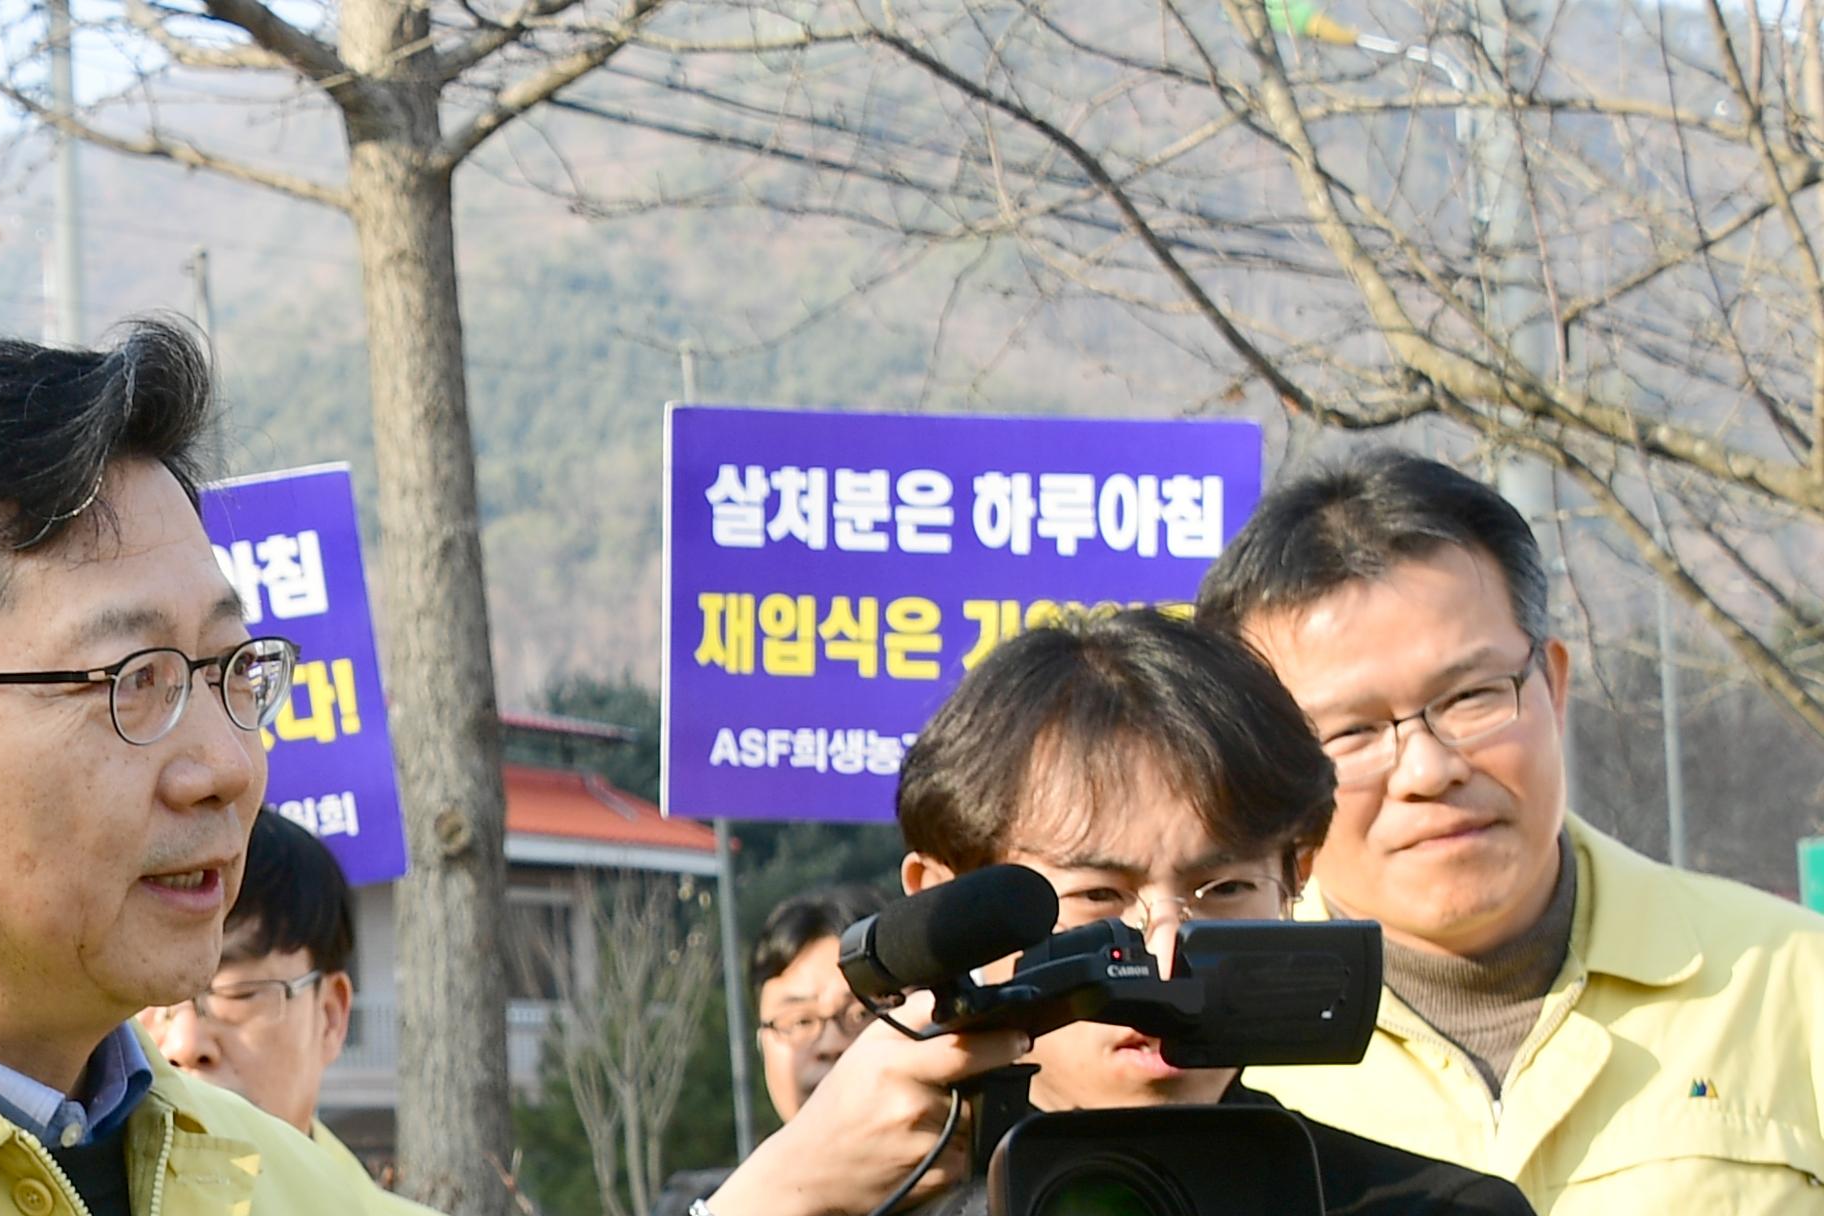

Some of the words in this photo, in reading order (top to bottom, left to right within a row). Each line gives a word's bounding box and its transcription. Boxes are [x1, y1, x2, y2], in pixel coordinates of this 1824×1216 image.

[705, 463, 954, 554] 살처분은
[972, 471, 1225, 559] 하루아침
[210, 529, 330, 626] 아침
[694, 593, 944, 680] 재입식은
[262, 657, 362, 752] 다!
[709, 727, 918, 776] ASF희생농
[1106, 964, 1150, 978] Canon
